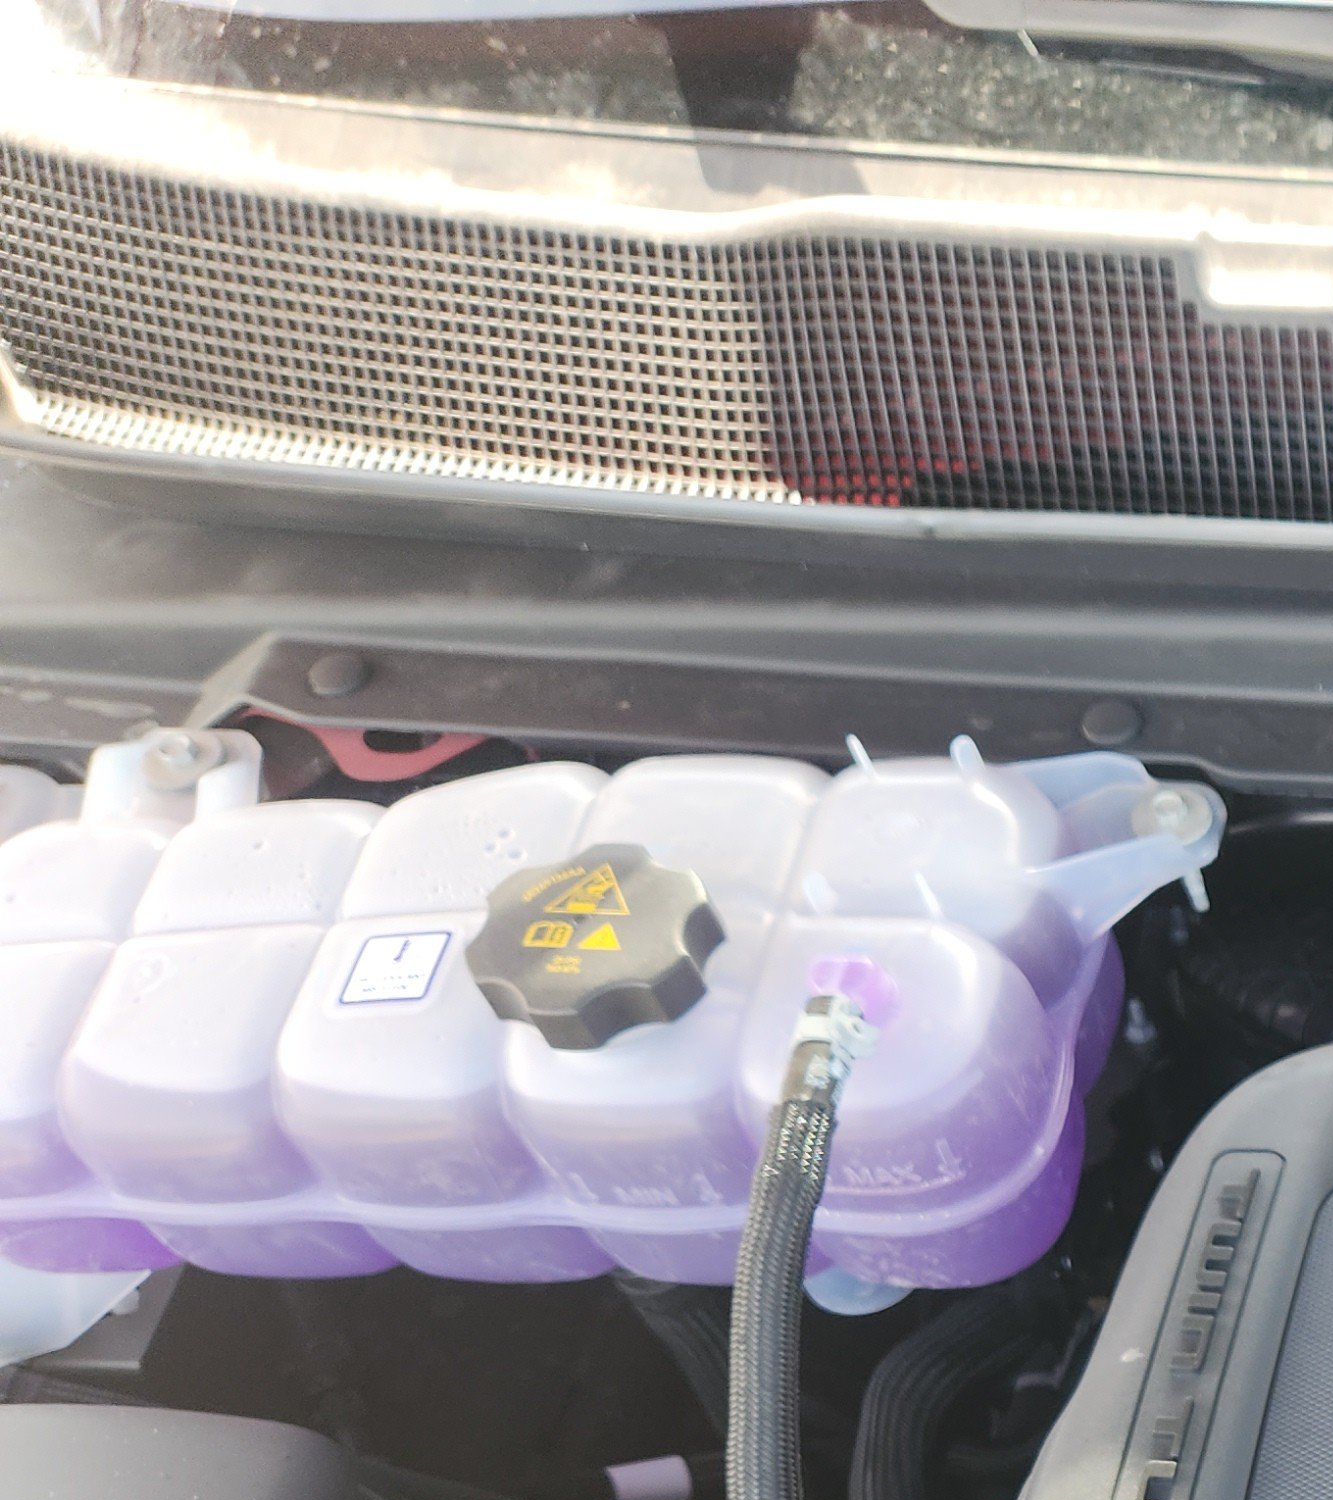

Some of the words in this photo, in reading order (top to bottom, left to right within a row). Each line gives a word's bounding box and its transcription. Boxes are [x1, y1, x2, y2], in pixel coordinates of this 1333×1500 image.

[841, 1162, 923, 1186] MAX
[610, 1185, 681, 1206] MIN
[1168, 1167, 1262, 1376] TWIN
